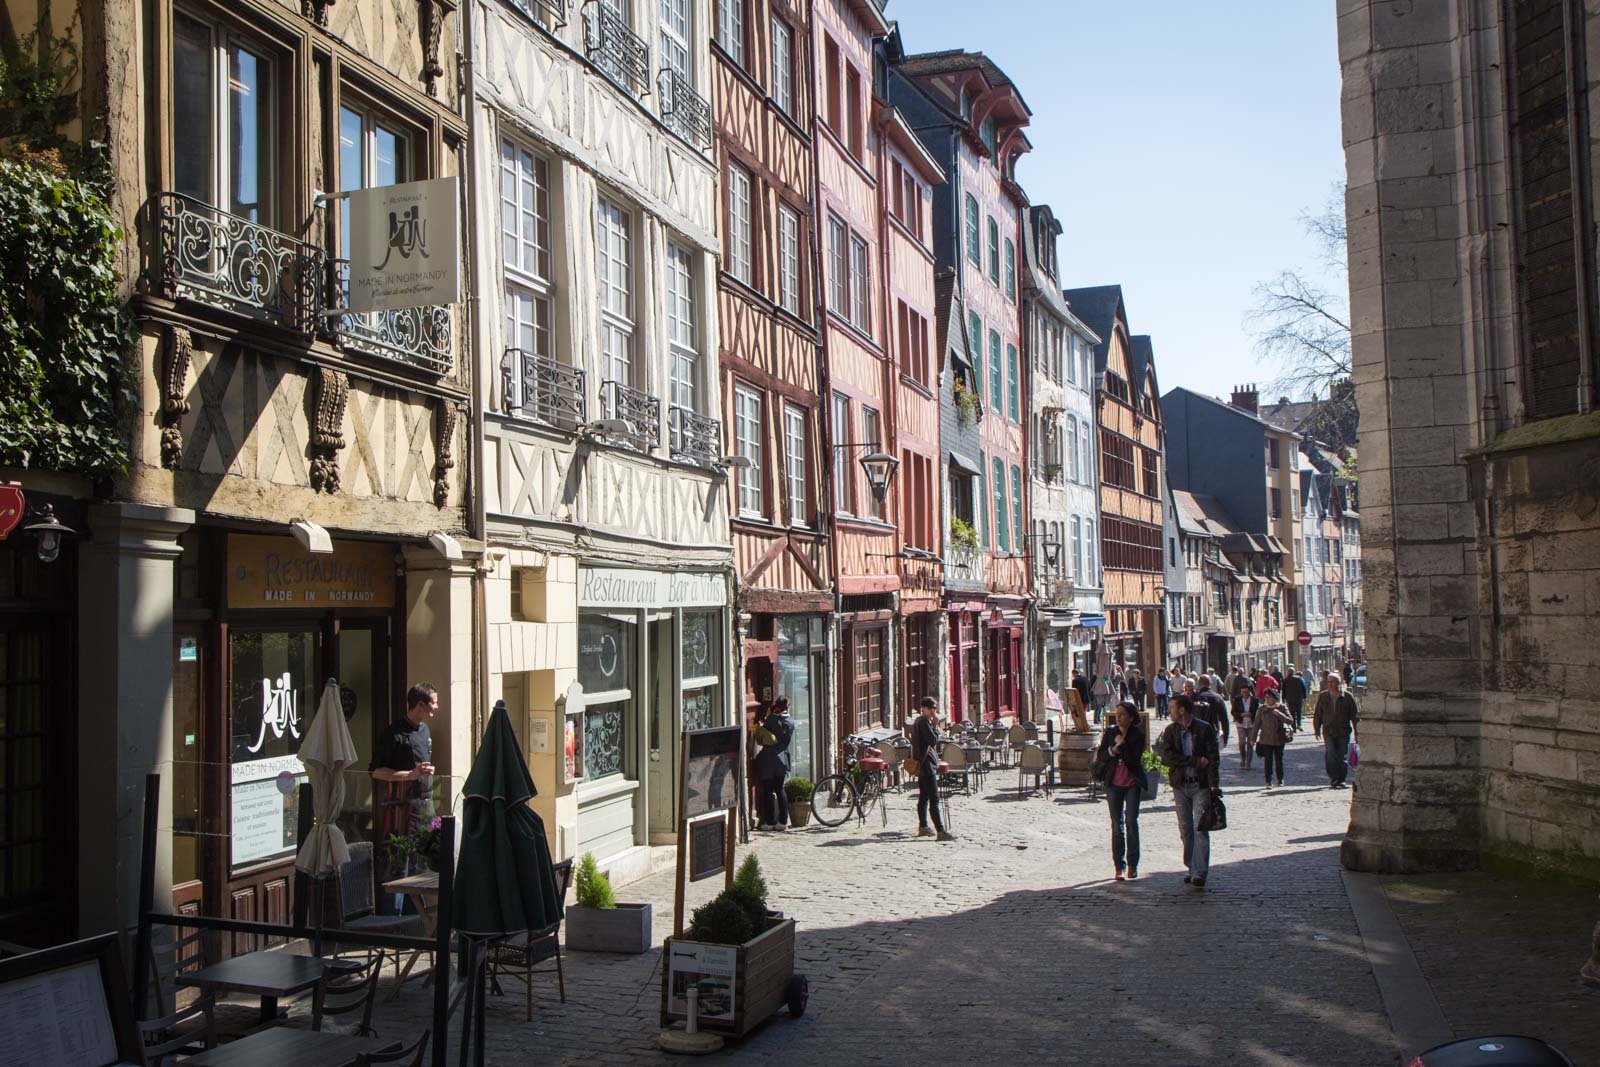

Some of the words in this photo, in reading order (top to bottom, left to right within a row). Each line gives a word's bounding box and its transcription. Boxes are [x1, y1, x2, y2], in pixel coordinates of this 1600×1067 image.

[358, 276, 383, 289] MADE
[385, 275, 394, 286] IN
[396, 270, 448, 284] NORMANDY
[581, 567, 657, 604] Restaurant
[668, 573, 689, 603] Bar
[700, 575, 721, 603] Vins
[265, 590, 293, 602] MADE
[305, 590, 316, 602] IN
[329, 590, 376, 602] NORMANDY
[232, 764, 256, 777] MADE
[257, 762, 267, 775] IN
[269, 757, 300, 772] NORMA
